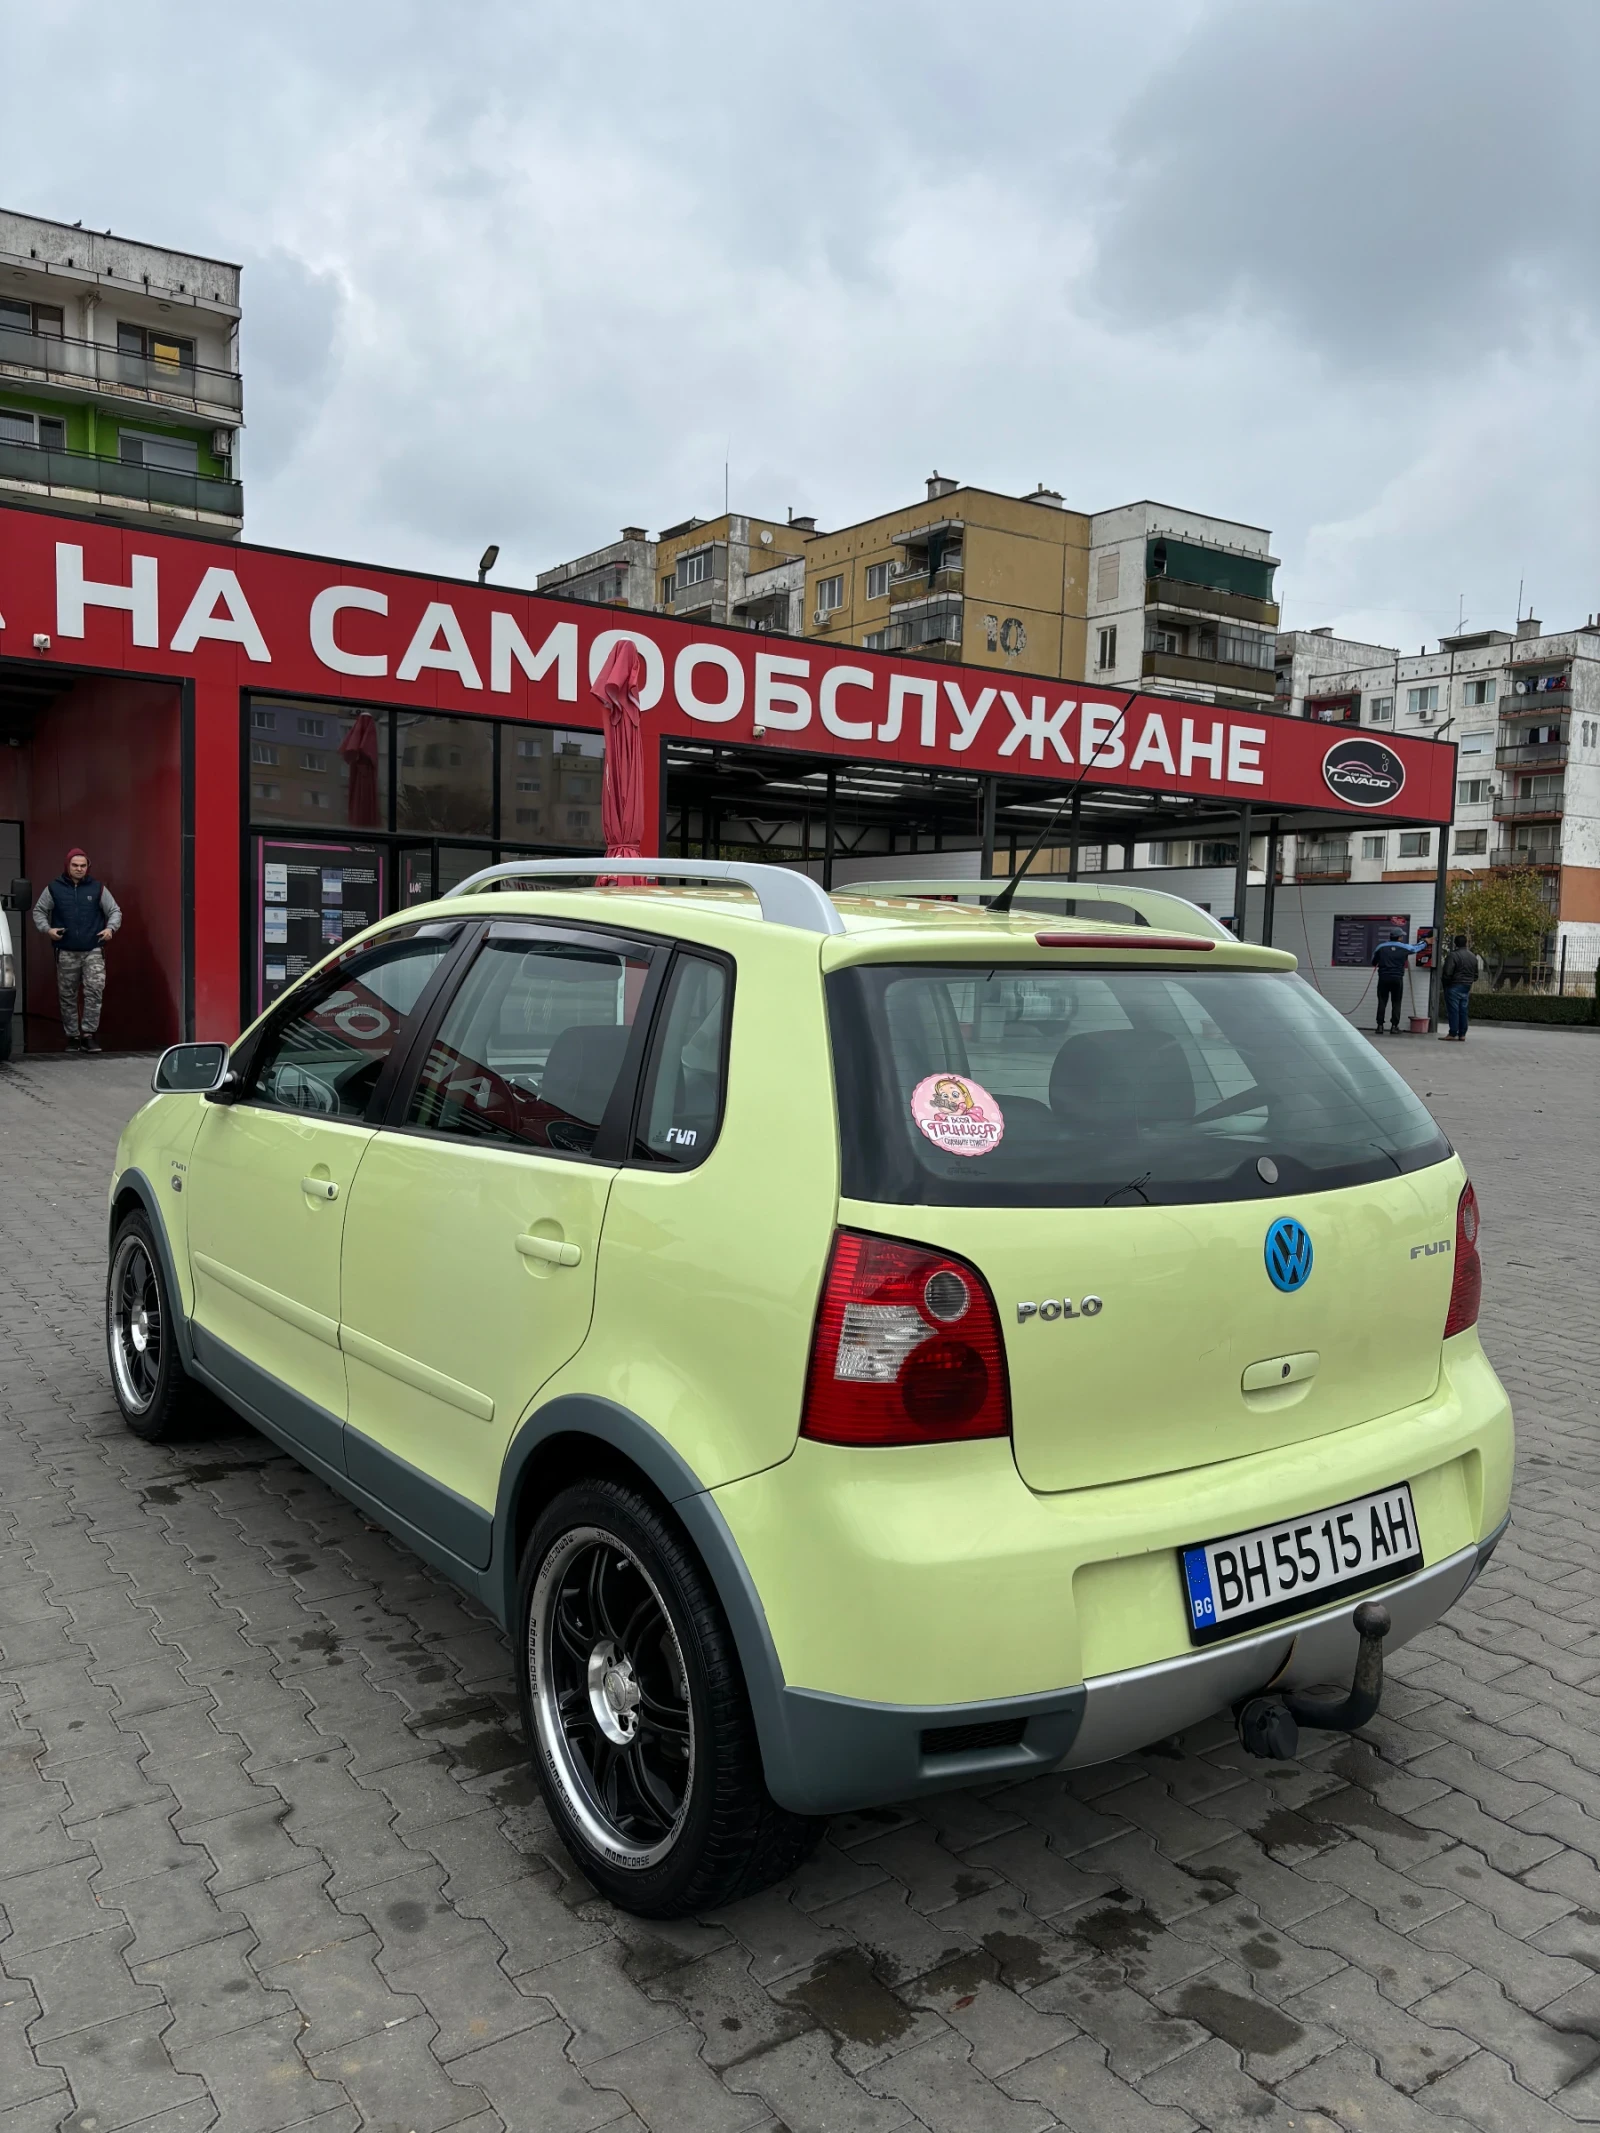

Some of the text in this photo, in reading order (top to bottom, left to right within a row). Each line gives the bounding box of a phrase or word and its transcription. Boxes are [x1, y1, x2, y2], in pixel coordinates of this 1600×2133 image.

[983, 614, 1027, 657] 10
[56, 542, 1266, 786] НА САМООБСЛУЖВАНЕ
[1333, 774, 1391, 788] LAVADO
[1017, 1294, 1103, 1324] POLO
[1194, 1597, 1213, 1617] BG
